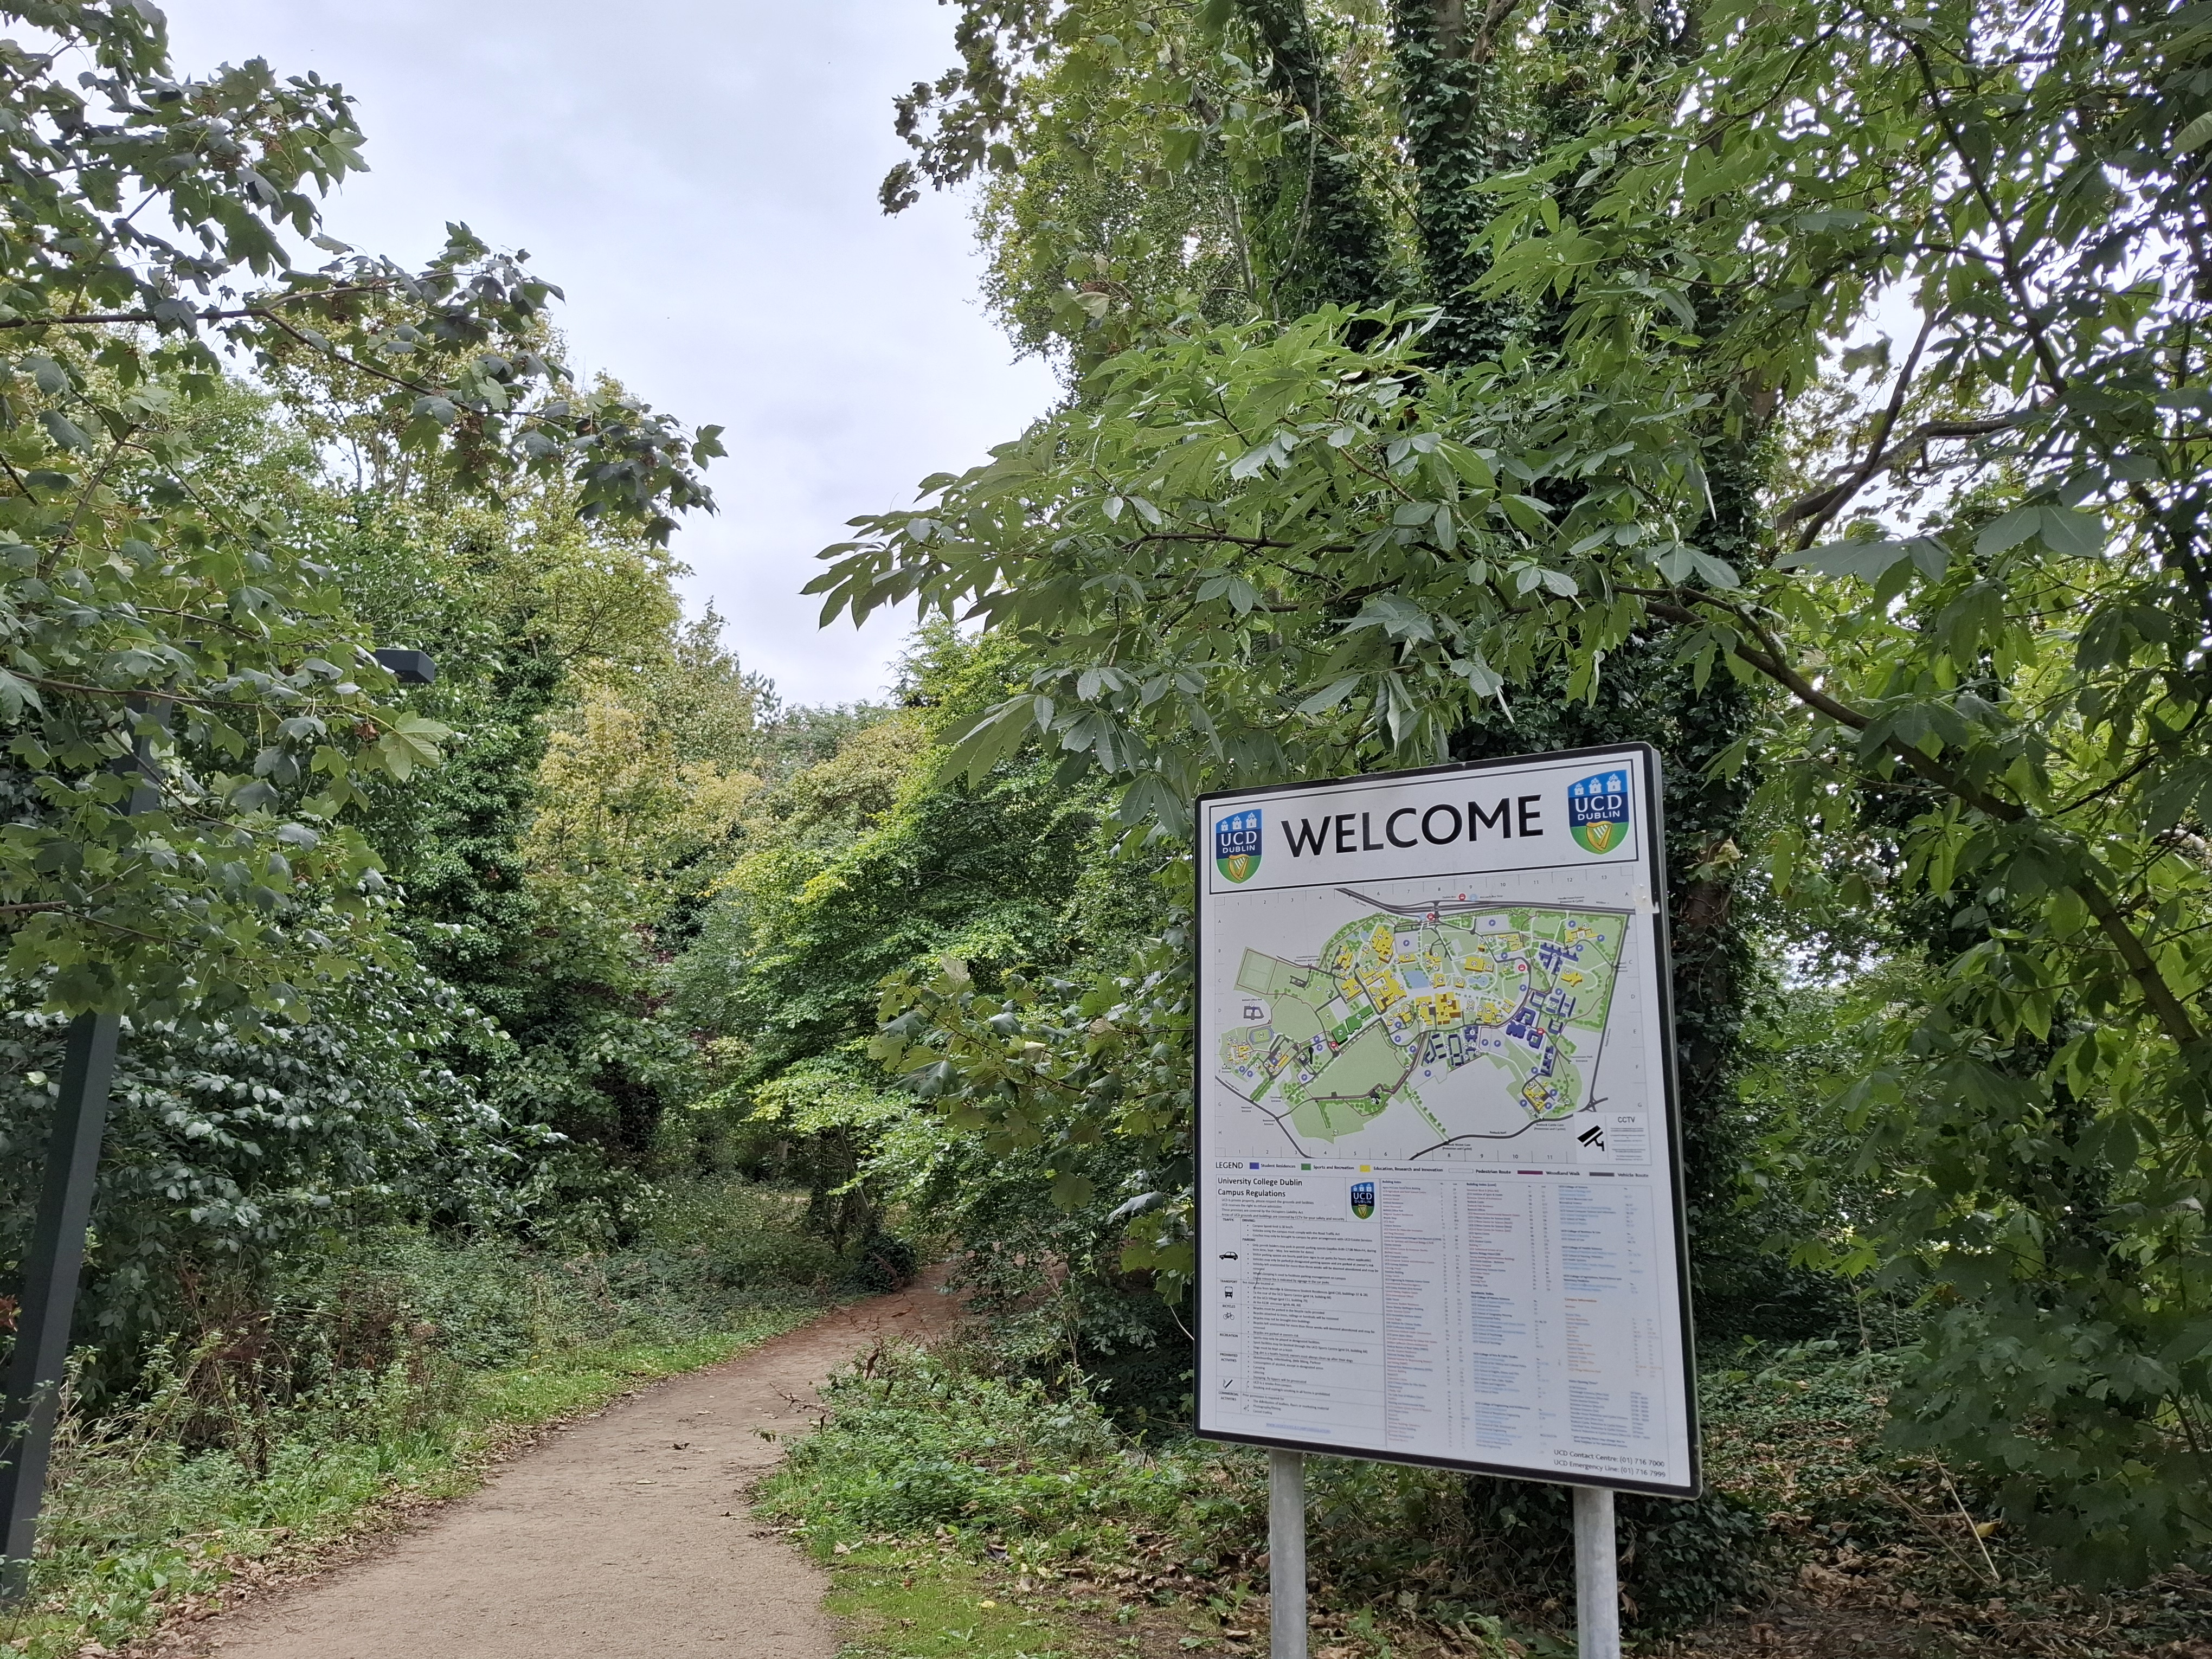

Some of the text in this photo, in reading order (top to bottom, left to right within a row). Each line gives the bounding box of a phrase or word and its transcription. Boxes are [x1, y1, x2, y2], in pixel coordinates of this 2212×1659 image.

[1574, 795, 1622, 812] UCD
[1578, 811, 1620, 820] DUBLIN
[1281, 794, 1544, 858] WELCOME
[1221, 831, 1257, 846] UCD
[1223, 845, 1255, 853] DUBLIN
[1218, 1177, 1251, 1186] University
[1253, 1178, 1278, 1186] College
[1218, 1188, 1286, 1198] Campus Regulations
[1620, 1456, 1632, 1465] (01)
[1570, 1461, 1603, 1472] Emergency
[1621, 1467, 1634, 1476] (01)
